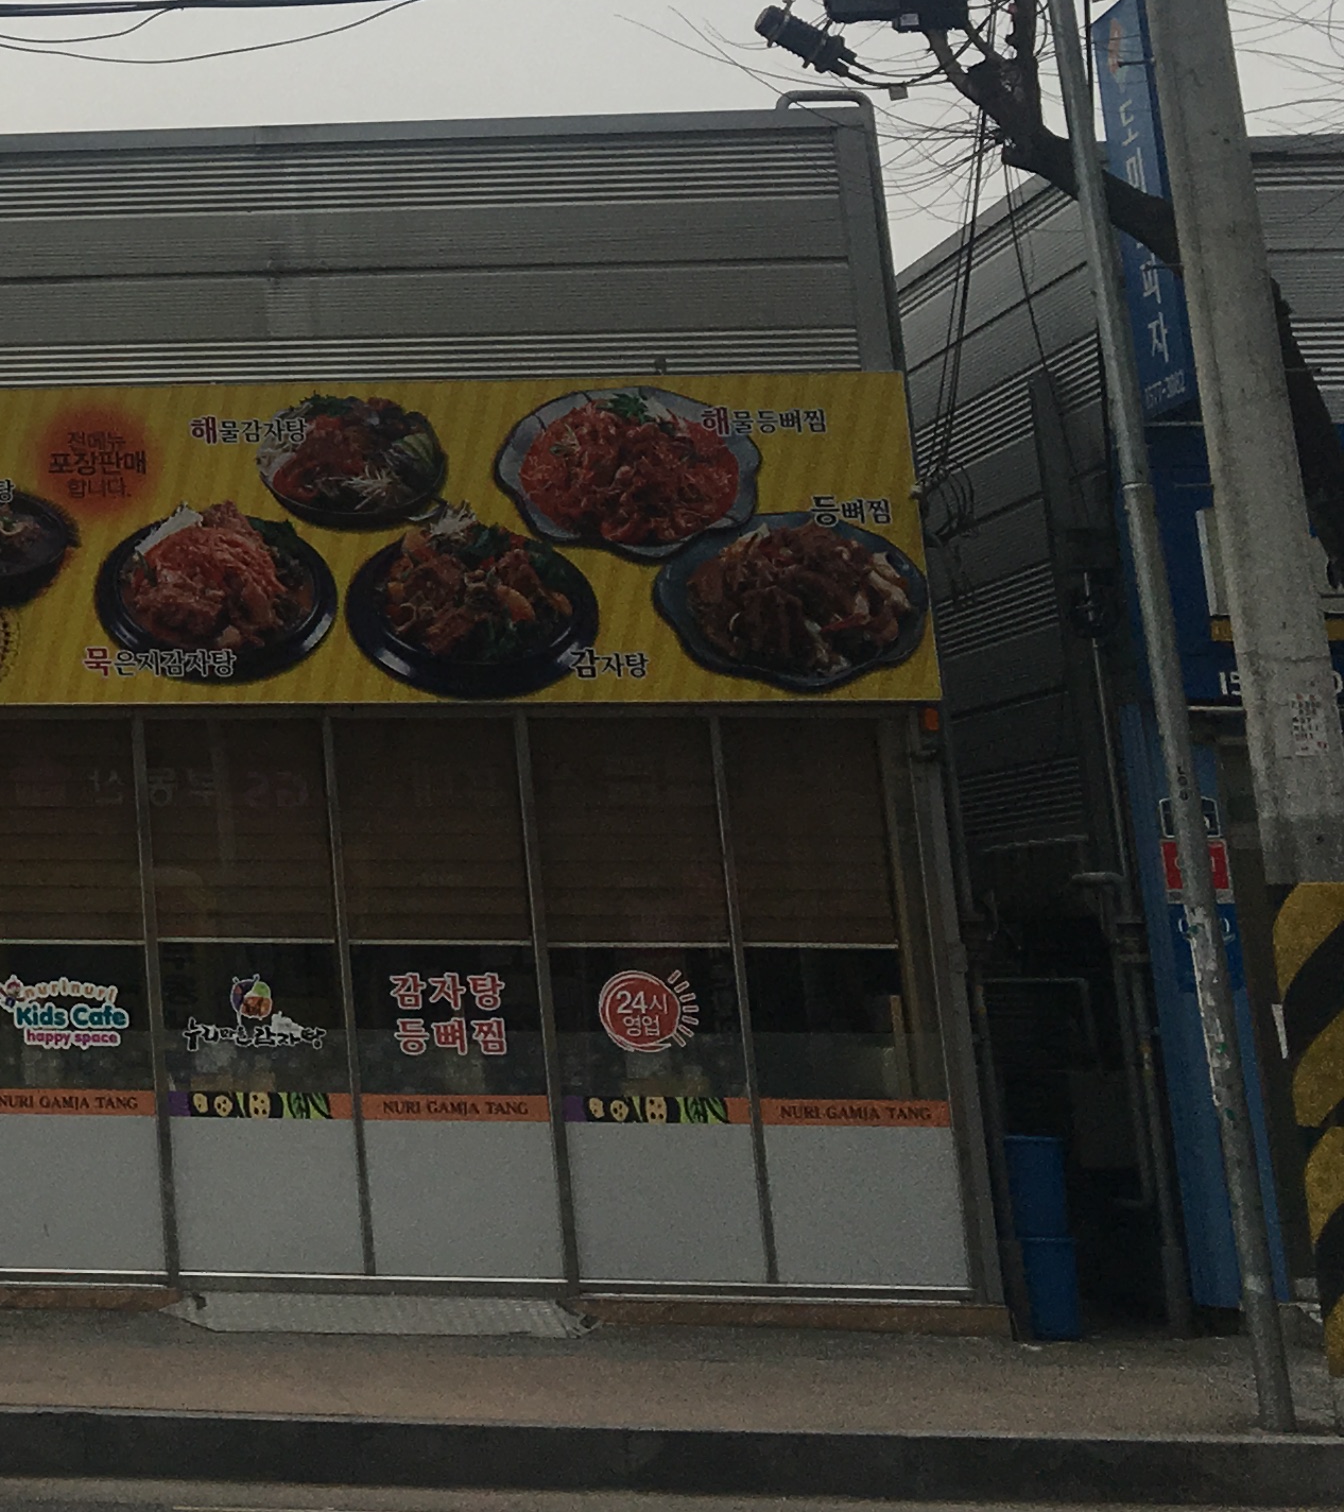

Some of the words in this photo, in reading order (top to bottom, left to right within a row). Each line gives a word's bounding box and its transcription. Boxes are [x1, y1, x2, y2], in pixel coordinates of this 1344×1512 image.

[189, 414, 308, 446] 해물감자탕
[700, 405, 828, 436] 해물등뼈찜
[67, 431, 126, 453] 전메뉴
[48, 450, 147, 476] 포장판매
[811, 494, 893, 526] 등뼈찜
[83, 646, 238, 678] 묵은지감자탕
[567, 647, 650, 679] 감자탕
[389, 971, 506, 1011] 감자탕
[615, 989, 669, 1016] 24시
[16, 1005, 66, 1026] Kids
[73, 1005, 127, 1026] Cafe
[622, 1014, 661, 1037] 영업
[27, 1028, 71, 1046] happy
[74, 1032, 118, 1046] space
[183, 1017, 251, 1051] 누리마을
[253, 1023, 327, 1049] 감자탕
[394, 1016, 508, 1055] 등뼈찜
[39, 1095, 91, 1111] GAMJA
[95, 1095, 139, 1110] TANG
[382, 1100, 422, 1116] NURI
[426, 1100, 481, 1117] GAMJA
[485, 1100, 529, 1116] TANG
[779, 1104, 824, 1120] NURI
[887, 1104, 933, 1120] TANG
